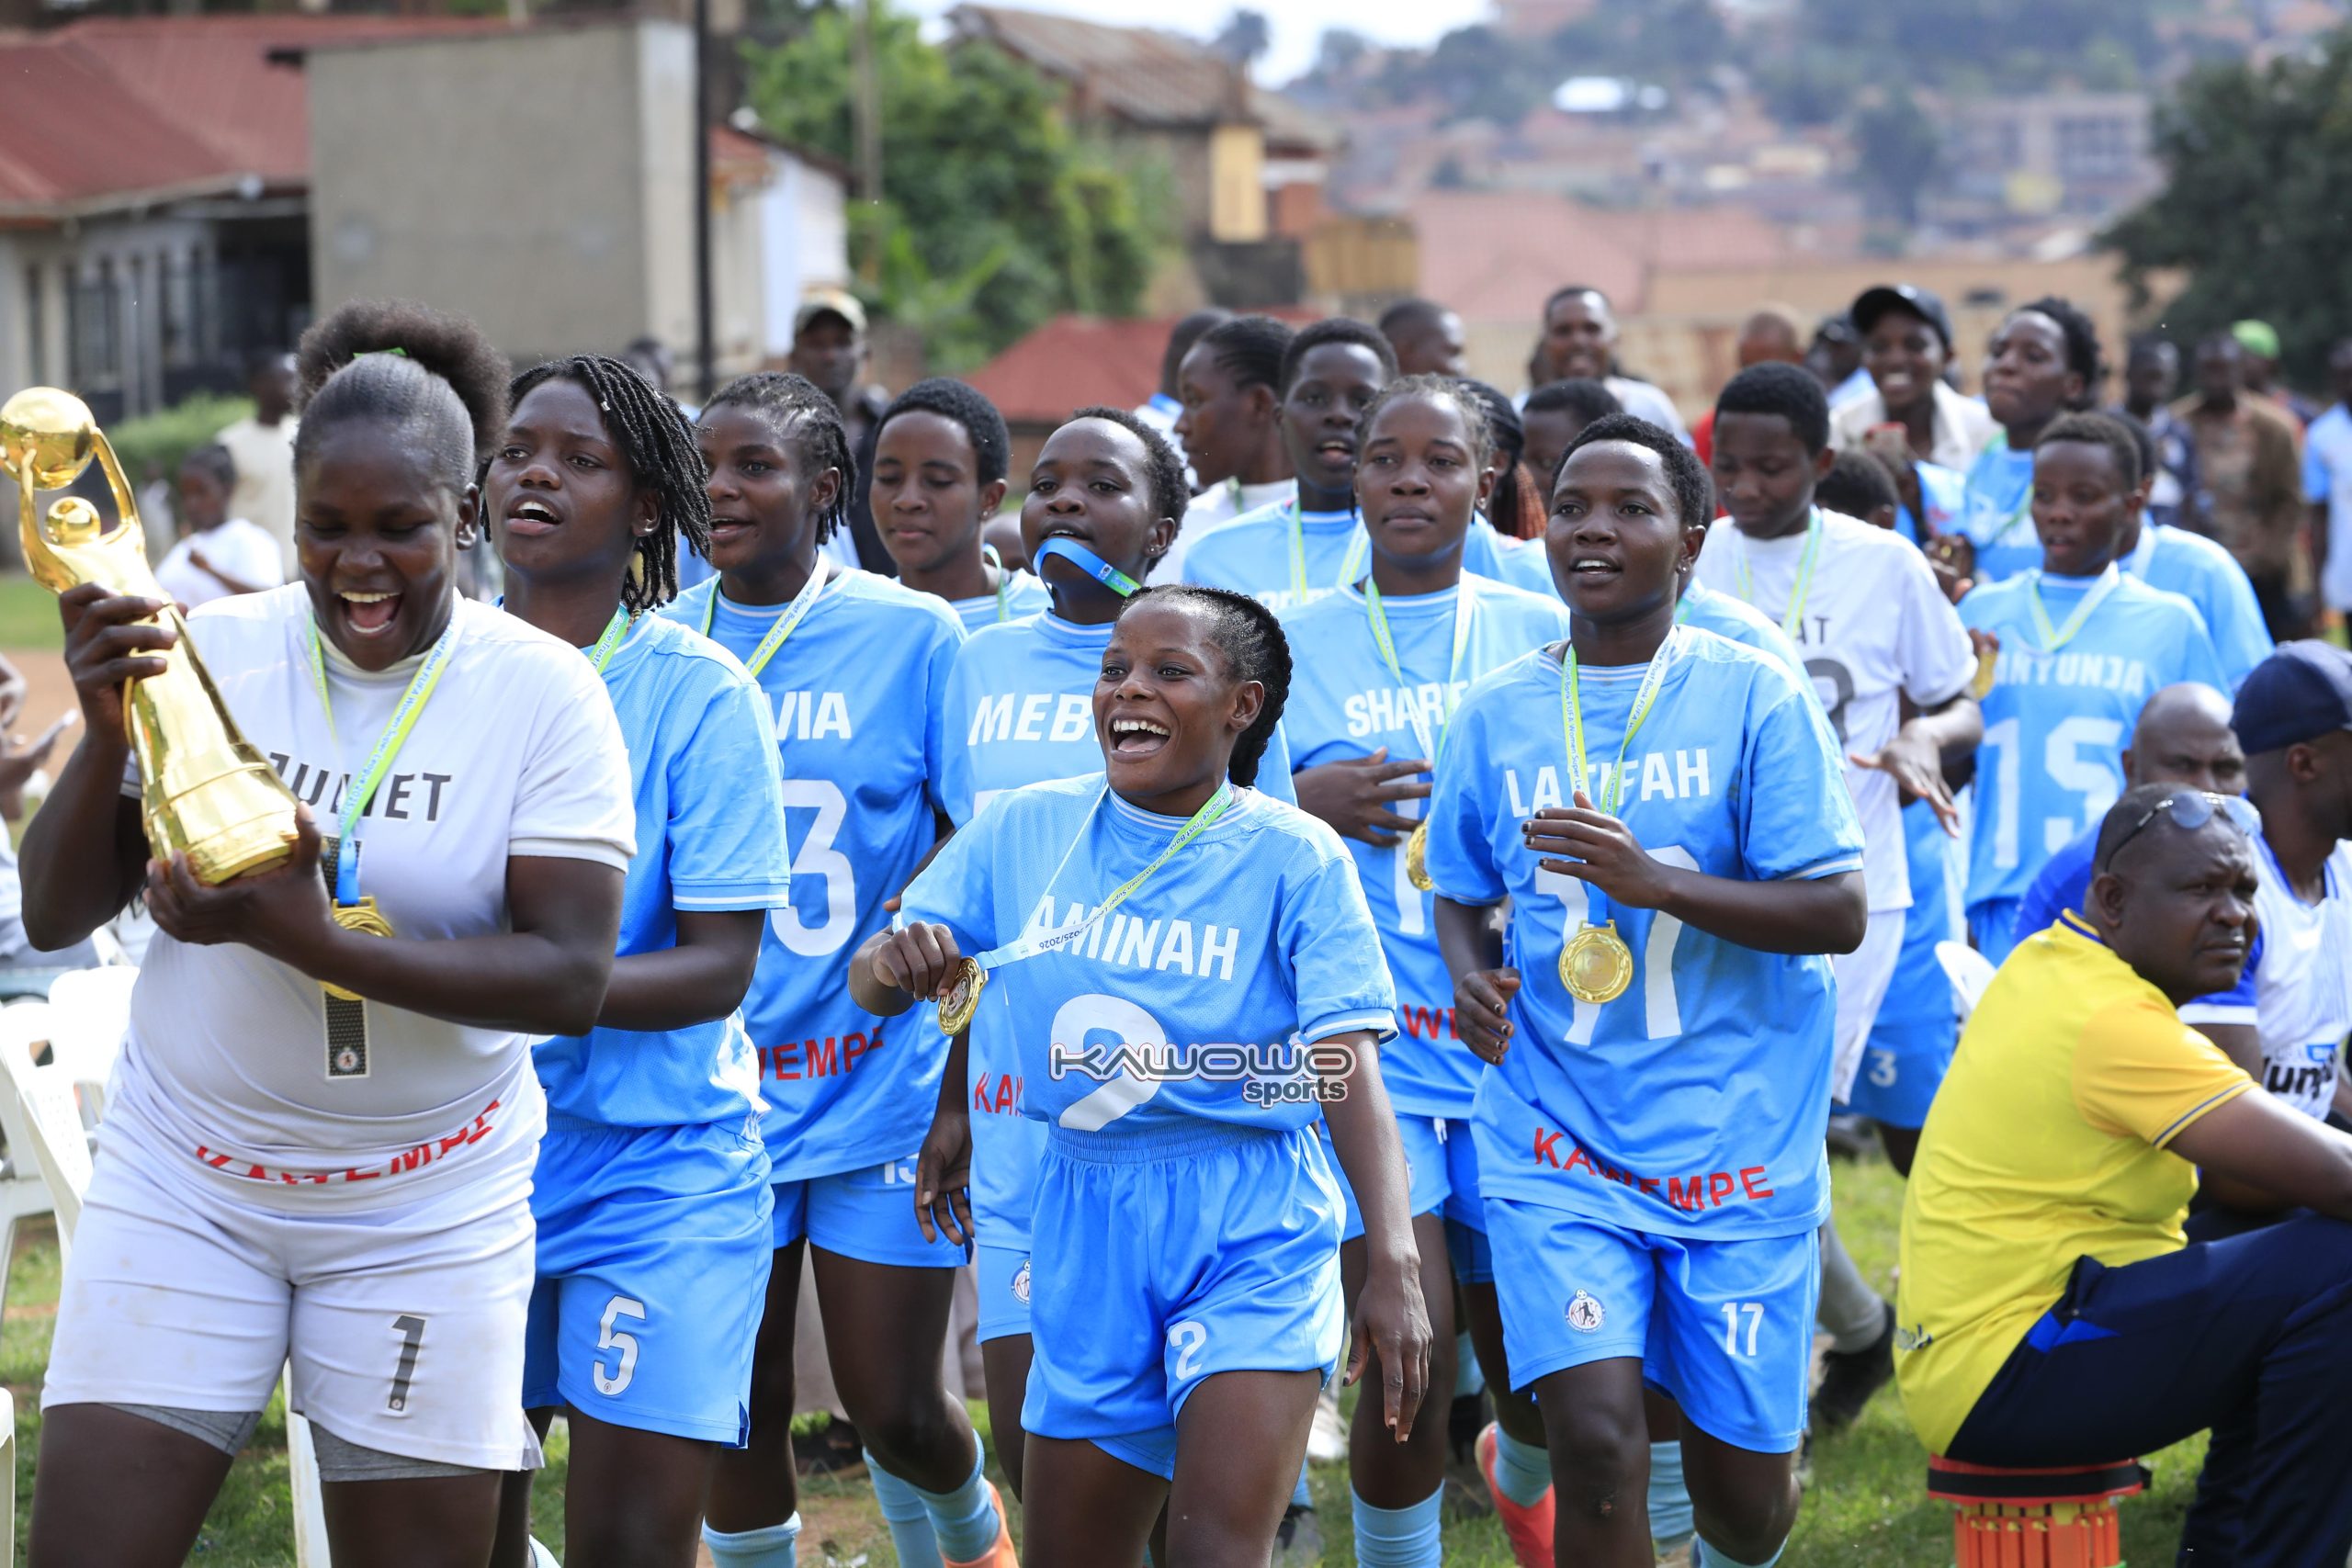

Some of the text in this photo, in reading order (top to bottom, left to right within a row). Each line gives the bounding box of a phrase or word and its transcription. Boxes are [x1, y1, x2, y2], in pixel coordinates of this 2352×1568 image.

[593, 640, 610, 663] Trust
[1639, 680, 1653, 698] Bank
[967, 693, 1101, 747] MEB
[1631, 699, 1645, 720] FUFA
[1568, 724, 1577, 753] Women
[1570, 755, 1580, 777] Super
[1983, 716, 2124, 869] 15
[1203, 795, 1227, 820] Finance
[1187, 820, 1204, 838] Trust
[1169, 835, 1187, 852] Bank
[1126, 868, 1153, 890] Women
[1107, 890, 1127, 908] Super
[1022, 895, 1239, 981] AMINAH
[1869, 1050, 1897, 1088] 3
[1721, 1302, 1764, 1358] 17
[592, 1294, 647, 1397] 5
[1169, 1321, 1207, 1381] 2
[386, 1313, 428, 1416] 1
